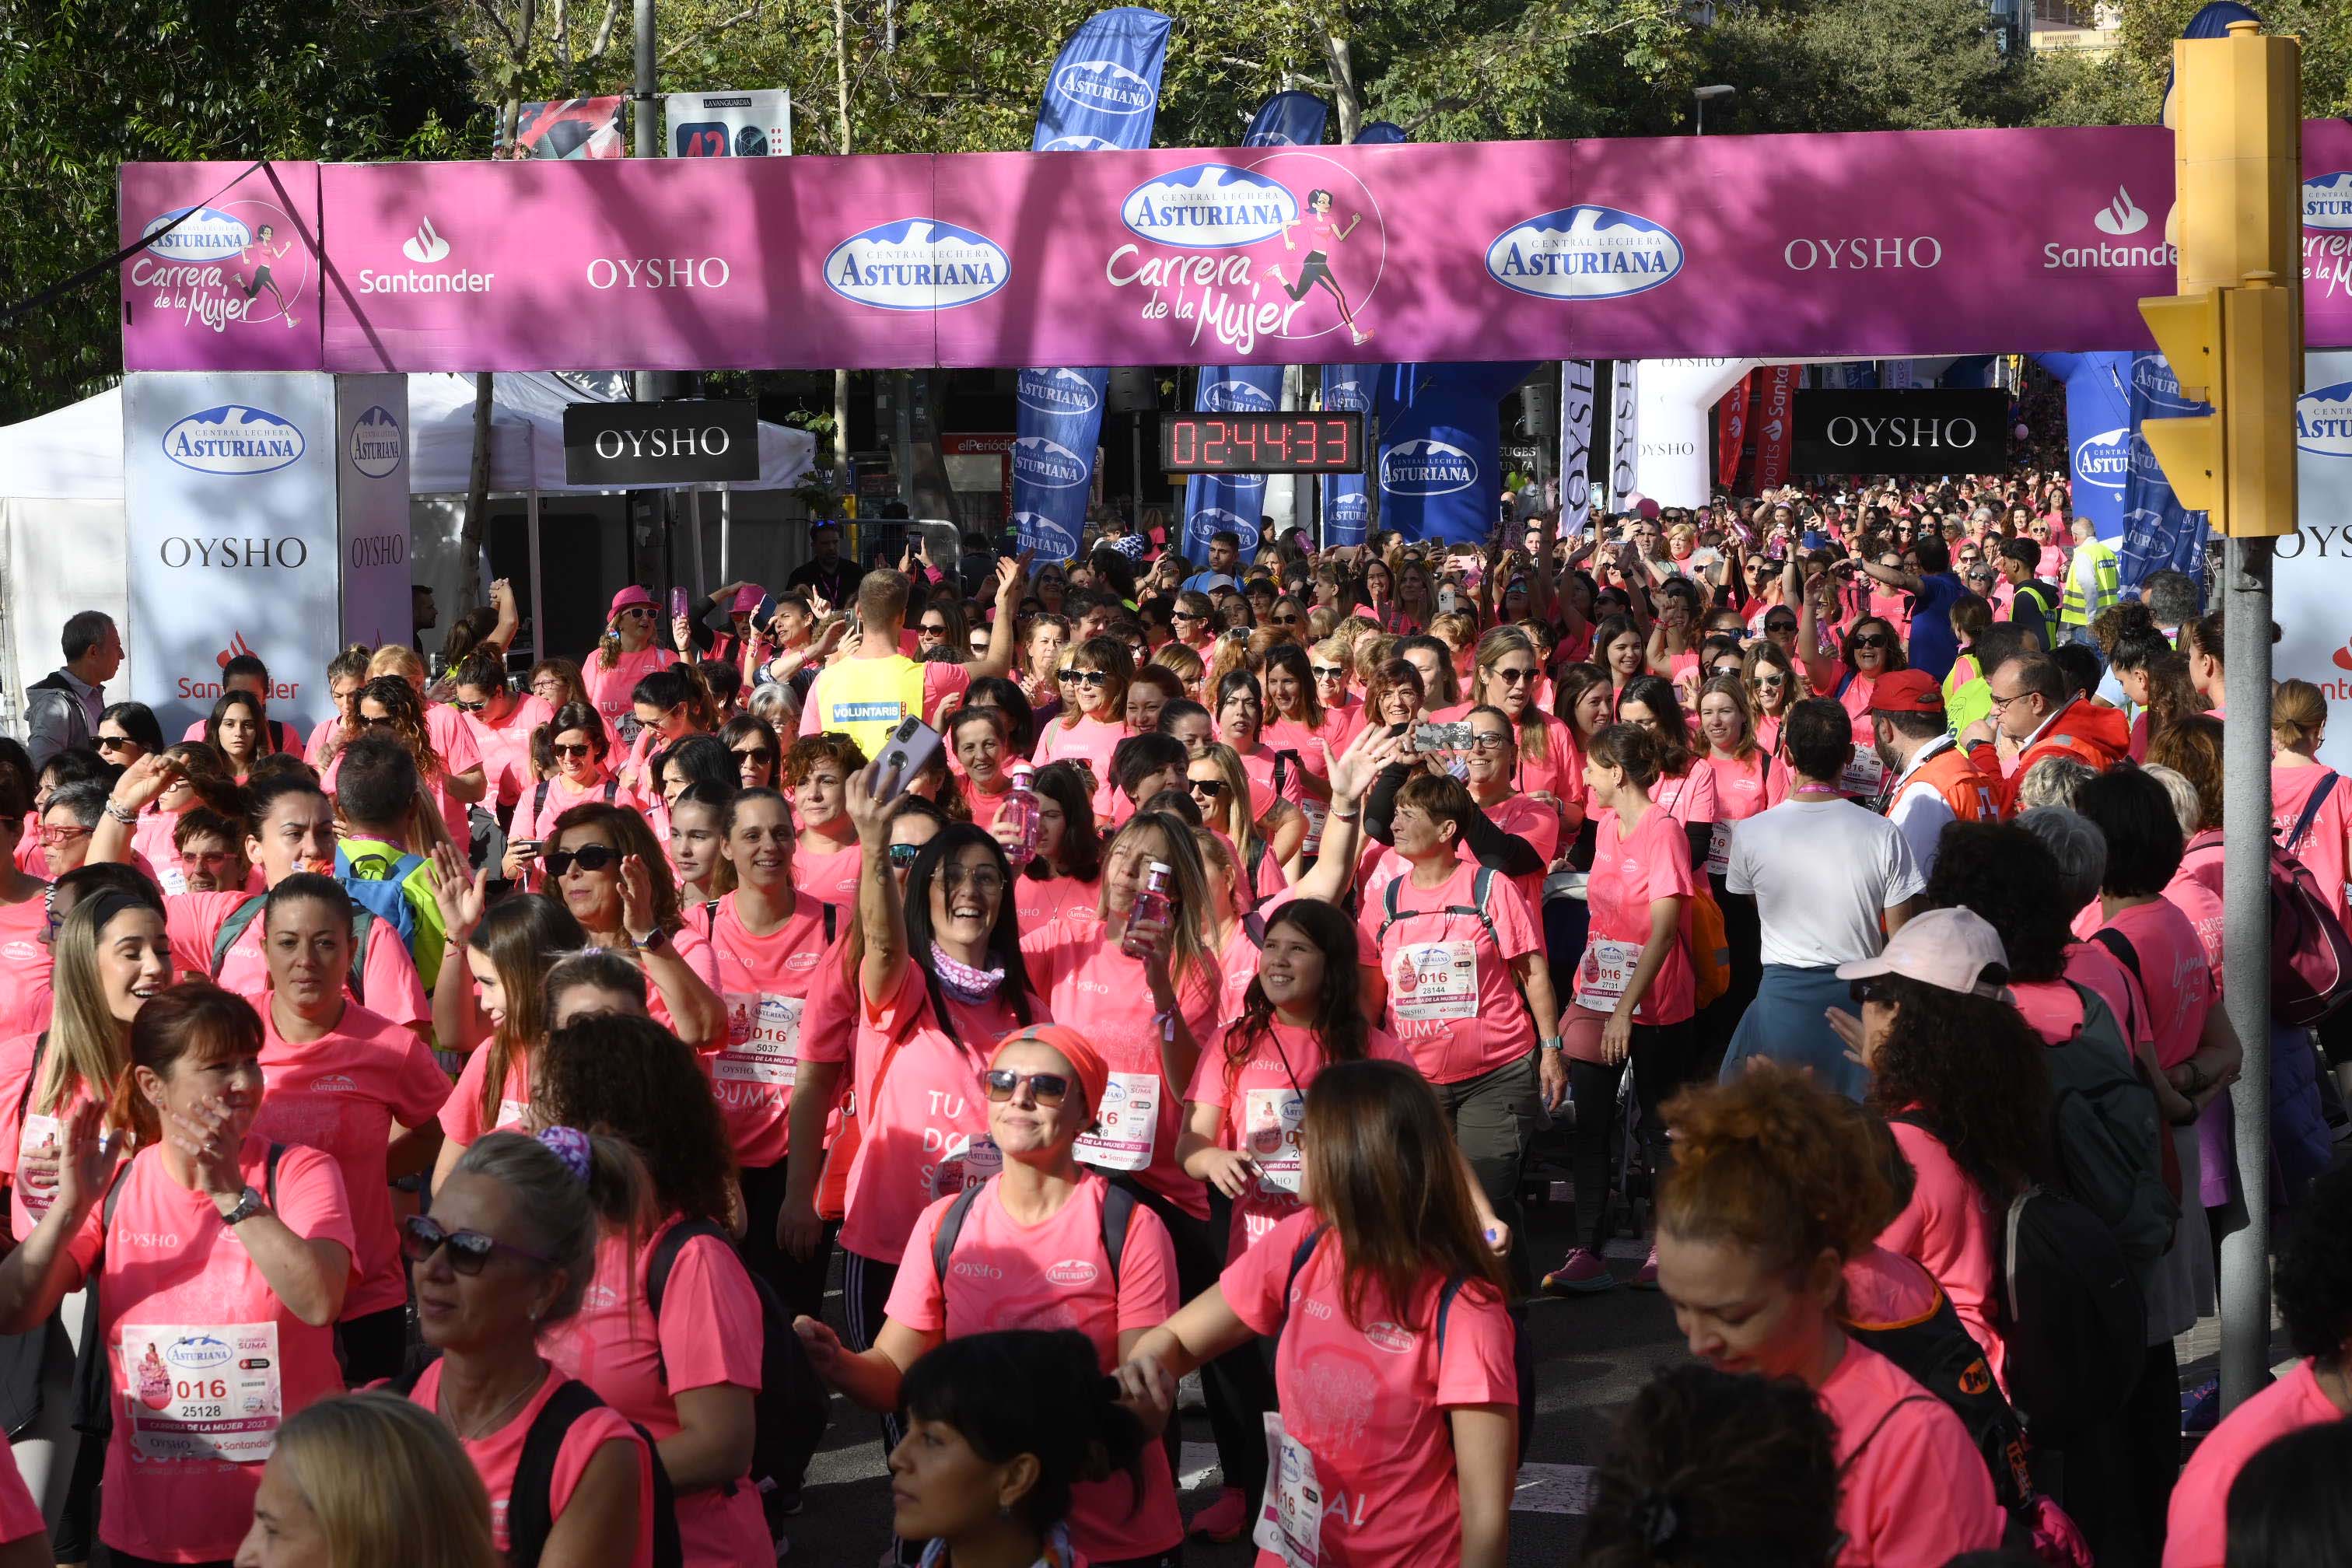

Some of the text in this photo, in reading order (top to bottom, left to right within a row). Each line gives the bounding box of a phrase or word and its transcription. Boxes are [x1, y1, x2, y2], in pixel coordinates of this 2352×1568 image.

[1062, 72, 1145, 107] ASTURIANA
[1161, 192, 1280, 202] CENTRAL LECHERA
[1135, 196, 1285, 227] ASTURIANA
[150, 227, 243, 248] ASTURIANA
[1531, 236, 1662, 249] CENTRAL LECHERA
[866, 248, 990, 261] CENTRAL LECHERA
[1500, 240, 1668, 277] ASTURIANA
[1784, 236, 1942, 271] OYSHO
[2043, 241, 2178, 268] Santande
[131, 257, 223, 287] Carrera
[586, 257, 730, 289] OYSHO
[838, 253, 996, 287] ASTURIANA
[1106, 243, 1251, 288] Carrera
[2315, 257, 2330, 279] la
[359, 268, 495, 294] Santander
[155, 283, 258, 333] de la Mujer
[1142, 282, 1307, 355] de la Mujer
[1017, 373, 1090, 408] ASTURIANA
[1768, 366, 1789, 417] Santa
[195, 429, 291, 437] CENTRAL LECHERA
[596, 426, 730, 459] OYSHO
[1174, 421, 1346, 464] 02:44:33
[1567, 360, 1592, 512] OYSH
[1826, 415, 1977, 448] OYSHO
[173, 430, 296, 458] ASTURIANA
[354, 432, 399, 461] ASTURIANA
[958, 439, 1013, 452] elPeriódi
[1017, 456, 1079, 481] STURIANA
[1384, 461, 1471, 483] ASTURIANA
[159, 537, 308, 569] OYSHO
[352, 534, 403, 569] OYSHO
[1017, 531, 1069, 556] TURIANA
[2272, 526, 2352, 558] OYS
[178, 677, 299, 699] Sander
[601, 701, 618, 712] TU
[834, 706, 898, 718] VOLUNTARIS
[1711, 837, 1725, 847] 16
[1419, 972, 1448, 984] 016
[1601, 969, 1622, 980] 016
[1423, 986, 1446, 995] 28144
[754, 1006, 790, 1020] ASTURIANA
[752, 1027, 787, 1042] 016
[1395, 1019, 1450, 1040] SUMA
[756, 1044, 779, 1053] 5037
[723, 1066, 754, 1076] OYSHO
[712, 1079, 785, 1109] SUMA
[928, 1089, 964, 1118] TU
[1097, 1110, 1118, 1125] 16
[27, 1199, 52, 1207] CARR
[118, 1228, 177, 1248] OYSHO
[1048, 1267, 1094, 1281] ASTURIANA
[1291, 1288, 1332, 1320] OSHO
[172, 1349, 227, 1361] ASTURIANA
[177, 1379, 226, 1400] 016
[182, 1405, 221, 1418] 25128
[187, 1423, 198, 1431] DE
[212, 1423, 243, 1431] MUJER
[247, 1420, 268, 1430] 2023
[149, 1439, 191, 1450] OYSHO
[224, 1439, 272, 1451] Santander
[1283, 1491, 1296, 1516] 16
